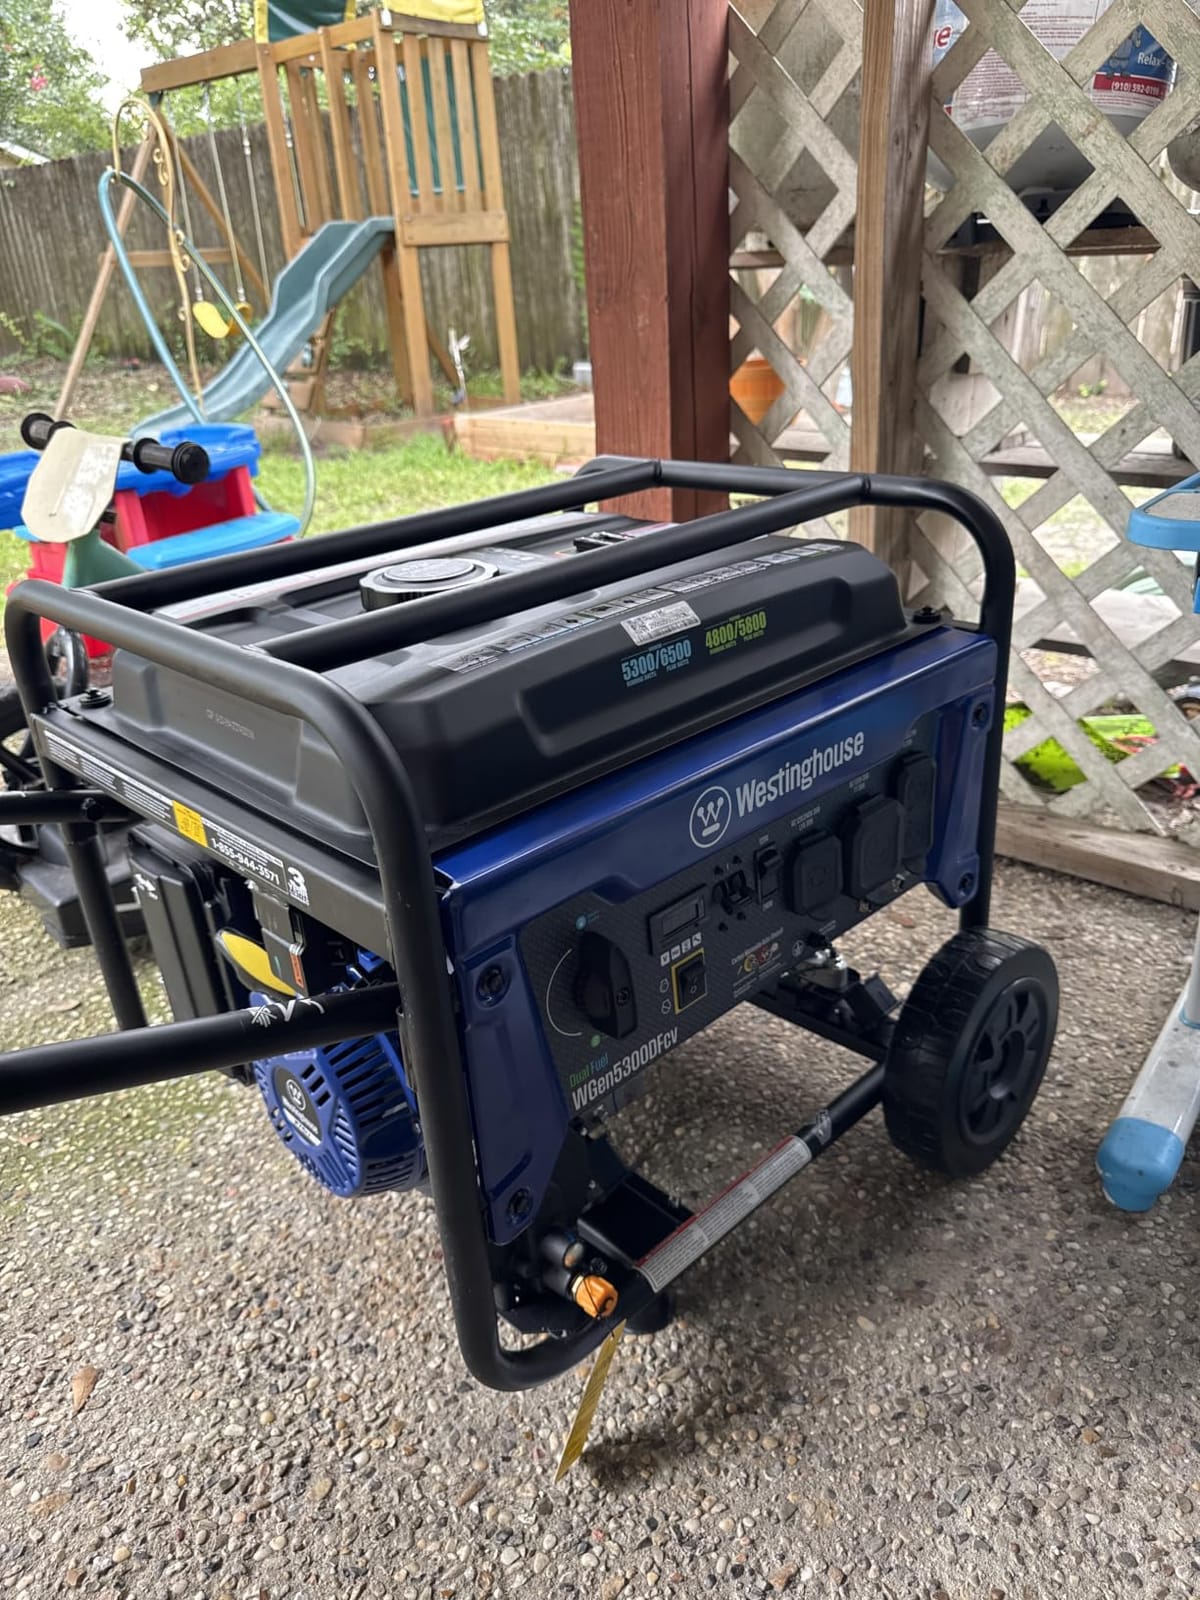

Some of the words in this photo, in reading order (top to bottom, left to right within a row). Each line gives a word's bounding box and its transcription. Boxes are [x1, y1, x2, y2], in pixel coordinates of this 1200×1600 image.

[706, 611, 767, 648] 4800/5800
[621, 639, 692, 680] 5300/6500
[736, 731, 864, 817] Westinghouse
[211, 838, 280, 885] 1-855-944-3571
[287, 866, 305, 888] 3
[569, 1064, 590, 1088] Dual
[590, 1053, 609, 1074] Fuel
[572, 1027, 680, 1111] WGen5300DFcv
